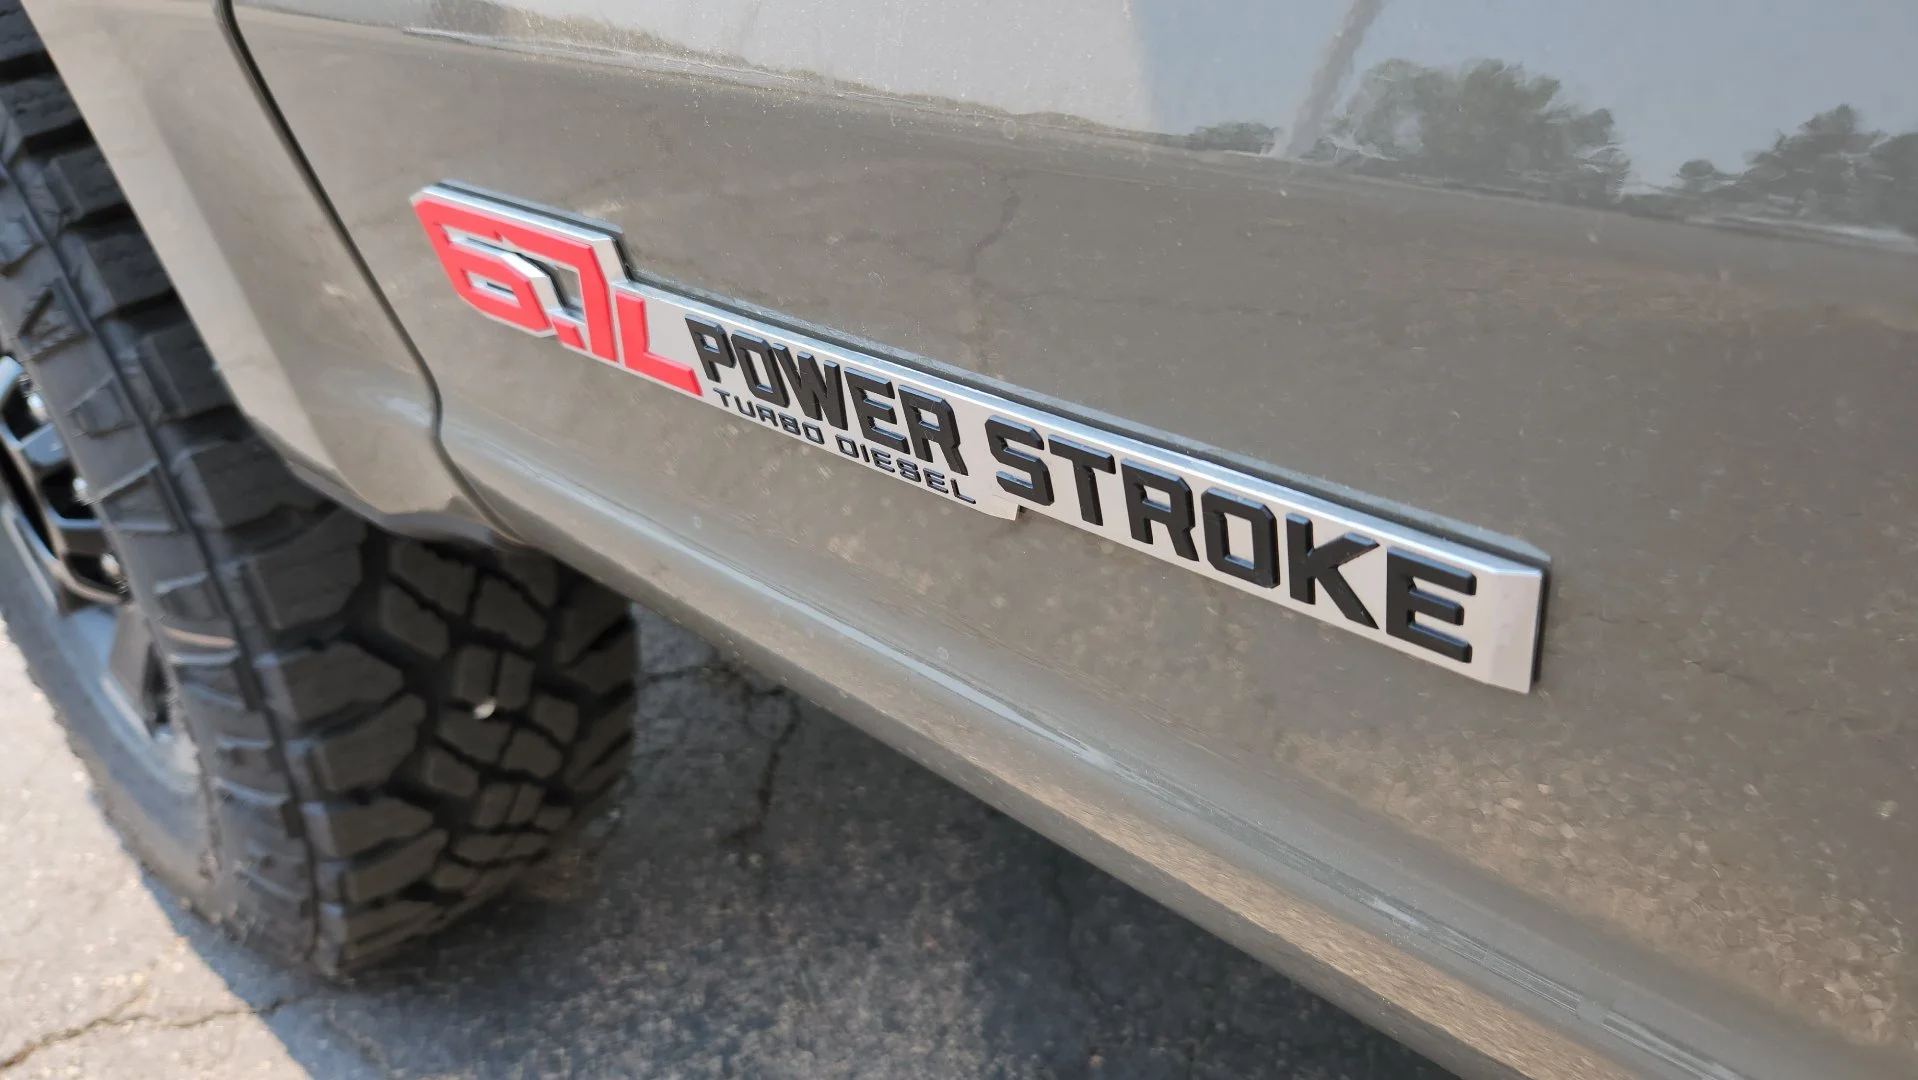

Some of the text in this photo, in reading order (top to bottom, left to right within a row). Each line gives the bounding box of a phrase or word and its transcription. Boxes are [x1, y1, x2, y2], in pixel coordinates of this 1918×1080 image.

[413, 199, 703, 398] 6.7L
[685, 314, 1477, 664] POWER STROKE
[713, 388, 977, 505] TURBO DIESEL
